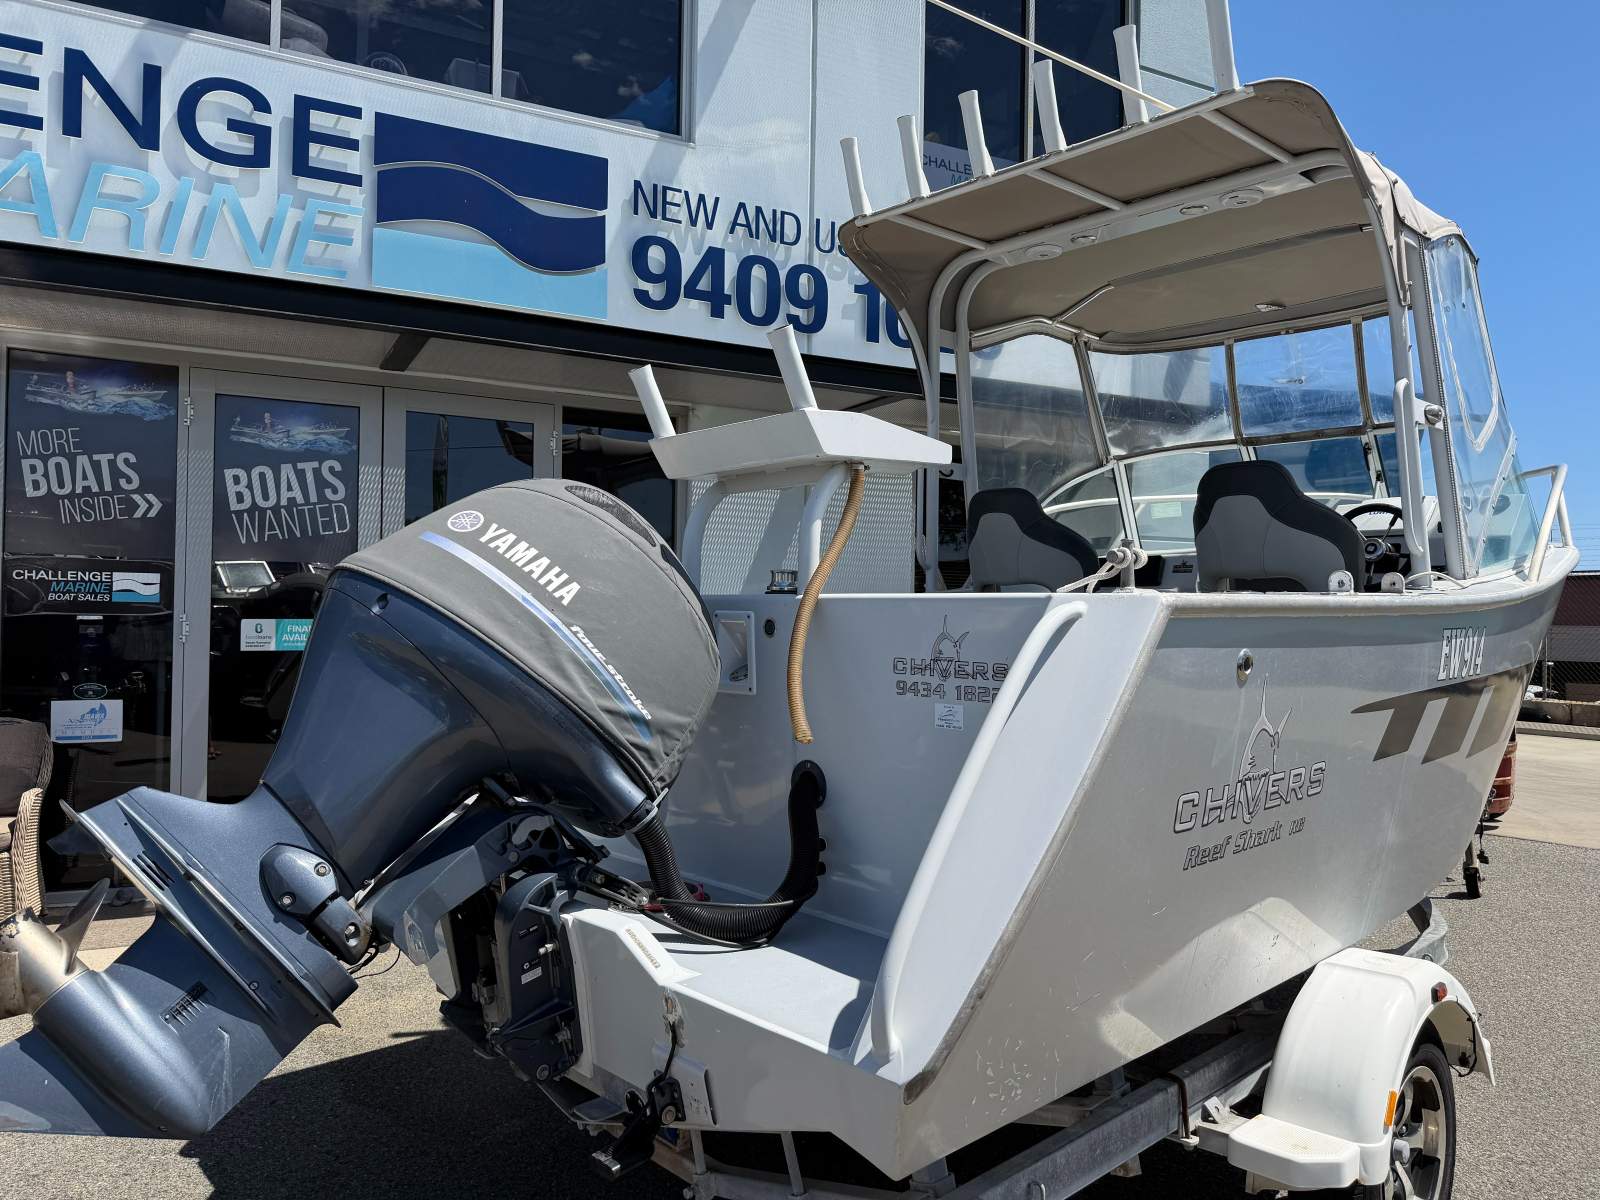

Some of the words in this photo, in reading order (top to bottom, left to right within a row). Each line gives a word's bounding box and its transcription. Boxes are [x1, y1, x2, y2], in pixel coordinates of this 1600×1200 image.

[632, 179, 720, 231] NEW
[729, 201, 802, 247] AND
[631, 235, 829, 334] 9409
[17, 428, 83, 456] MORE
[21, 452, 140, 498] BOATS
[223, 459, 346, 511] BOATS
[59, 494, 129, 525] INSIDE
[231, 502, 350, 544] WANTED
[12, 569, 111, 582] CHALLENGE
[479, 523, 581, 606] YAMAHA
[47, 593, 75, 601] BOAT
[77, 594, 110, 602] SALES
[50, 582, 111, 593] MARINE
[893, 657, 1009, 682] CHIVERS
[1437, 626, 1486, 681] EW914
[895, 680, 946, 700] 9434
[1173, 760, 1327, 834] CHIVERS
[1182, 834, 1232, 871] Reef
[1232, 820, 1282, 855] Shark
